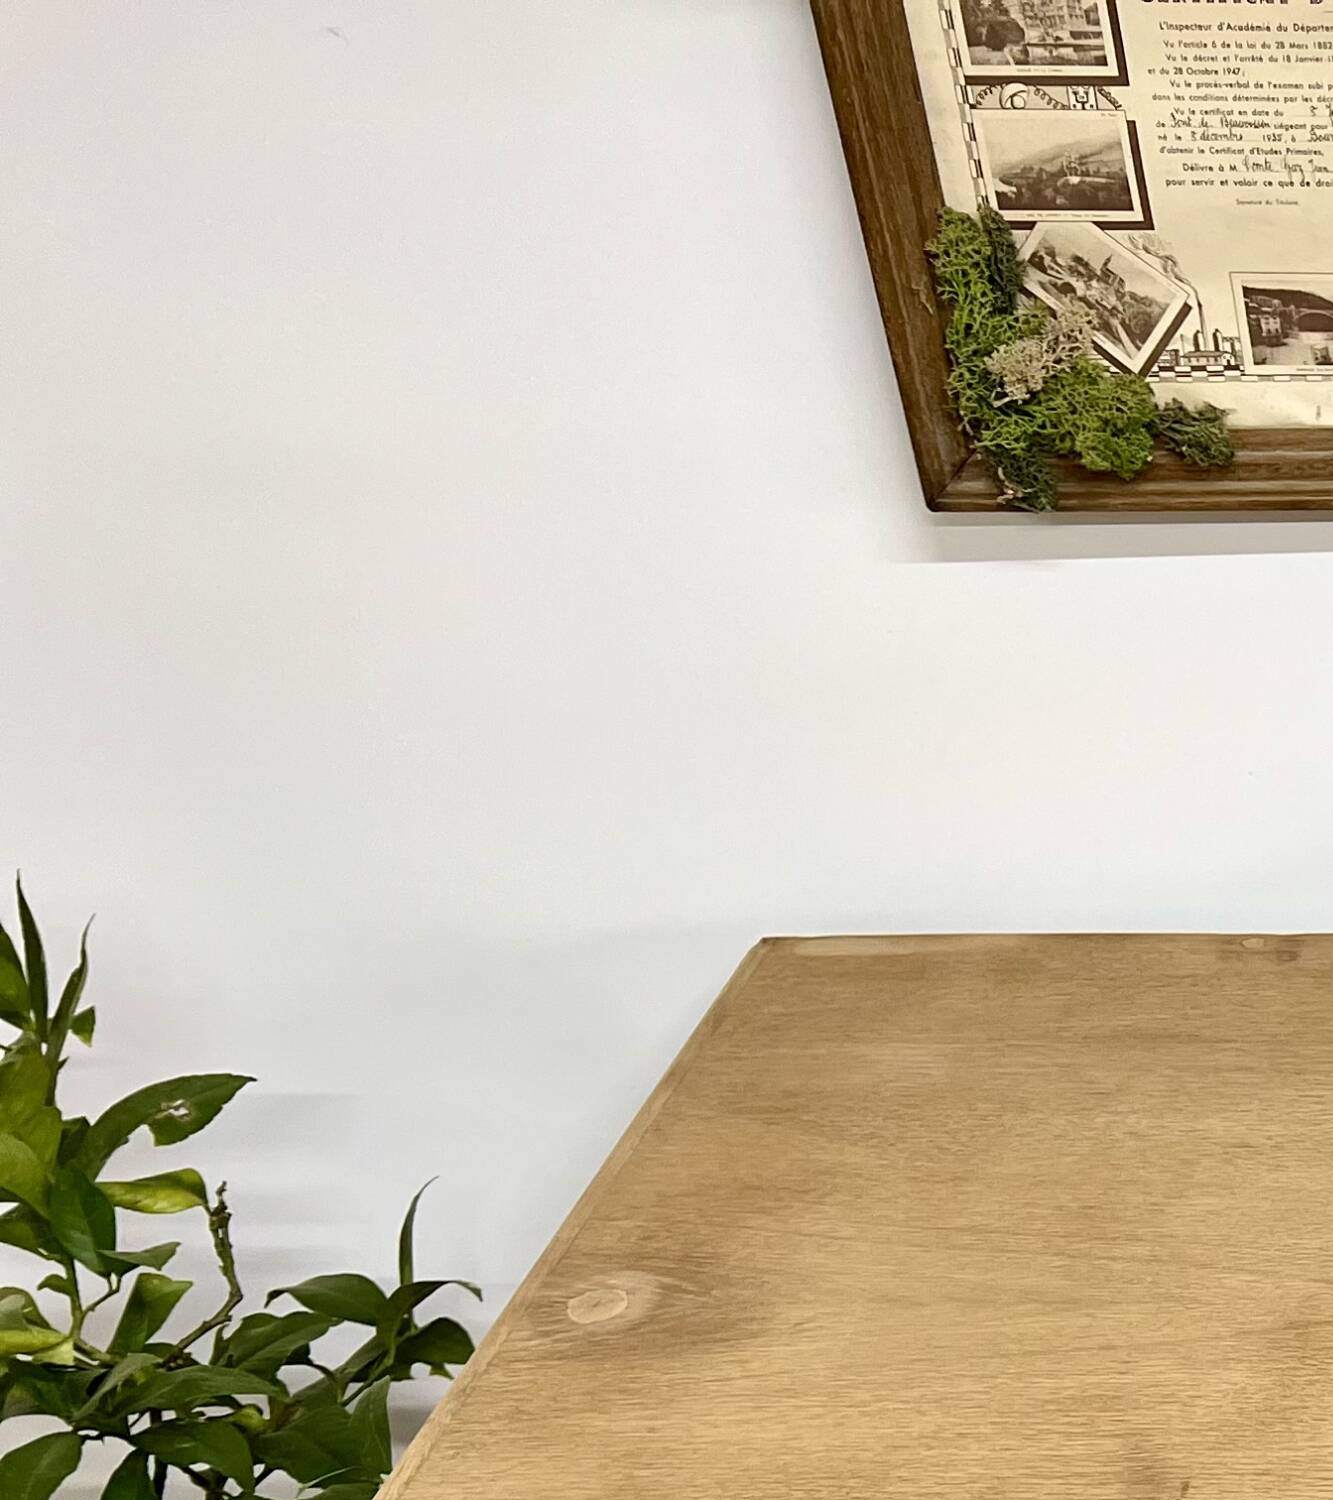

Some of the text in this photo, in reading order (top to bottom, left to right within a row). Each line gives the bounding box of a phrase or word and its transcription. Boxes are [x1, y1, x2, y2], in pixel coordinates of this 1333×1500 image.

[1159, 21, 1212, 32] L'Inspecteur
[1277, 23, 1288, 32] du
[1165, 179, 1186, 187] pour
[1191, 178, 1214, 186] servir
[1233, 178, 1258, 187] valoir
[1263, 179, 1273, 187] ce
[1278, 179, 1295, 189] que
[1300, 178, 1310, 187] de
